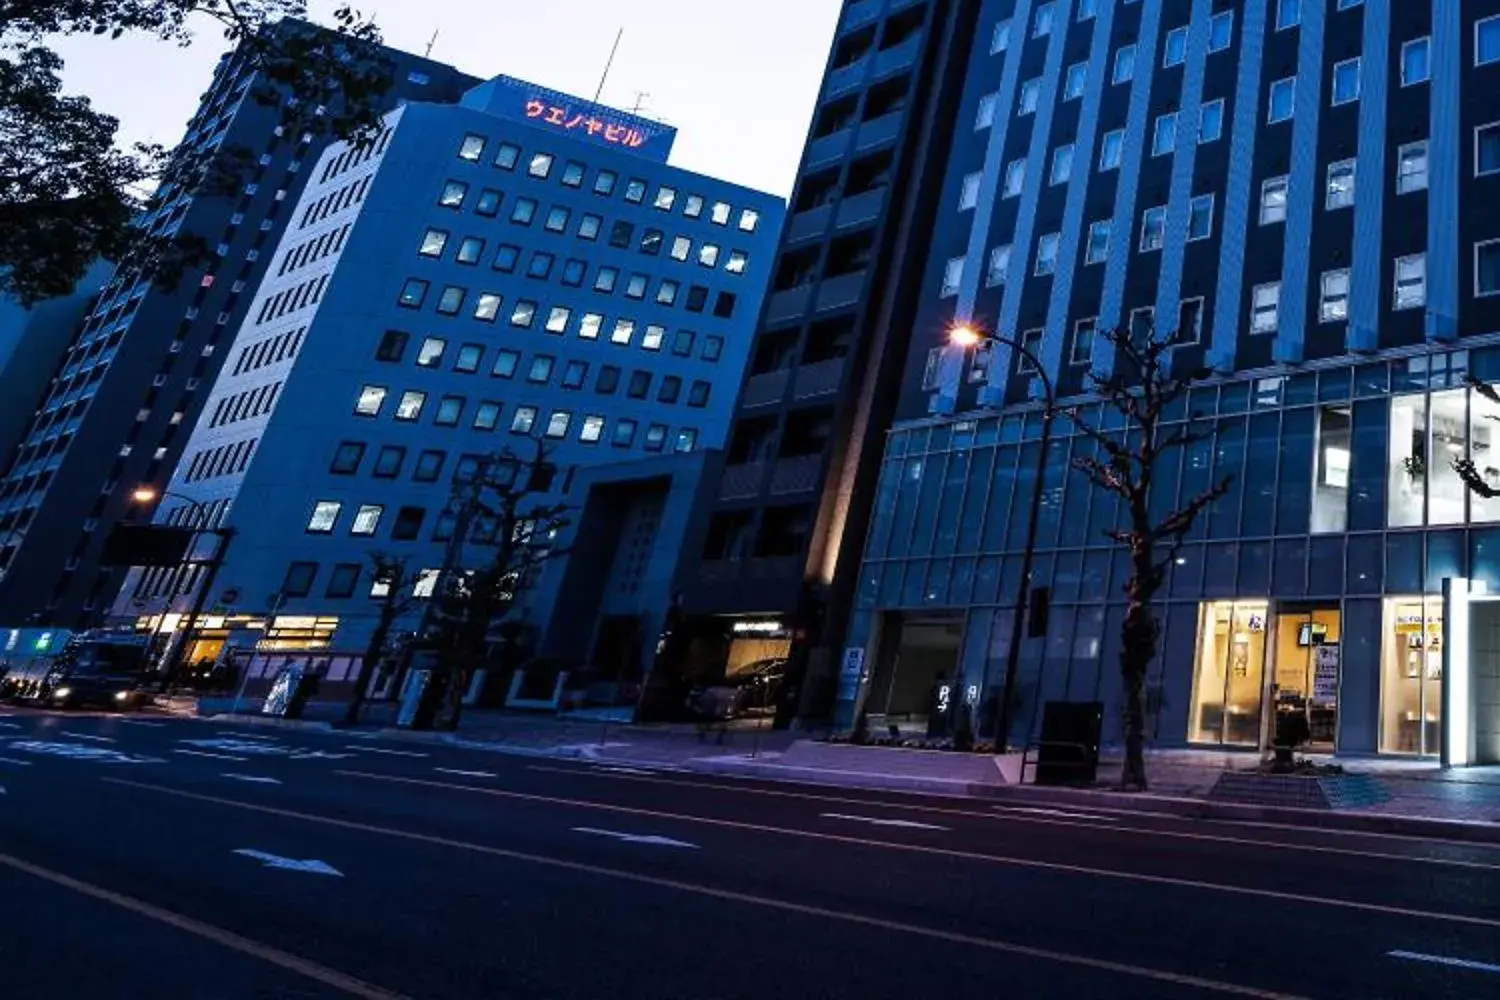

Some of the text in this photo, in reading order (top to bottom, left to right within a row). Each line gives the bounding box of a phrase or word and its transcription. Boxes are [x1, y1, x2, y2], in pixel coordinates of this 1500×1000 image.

[525, 99, 644, 148] ウエノヤビル
